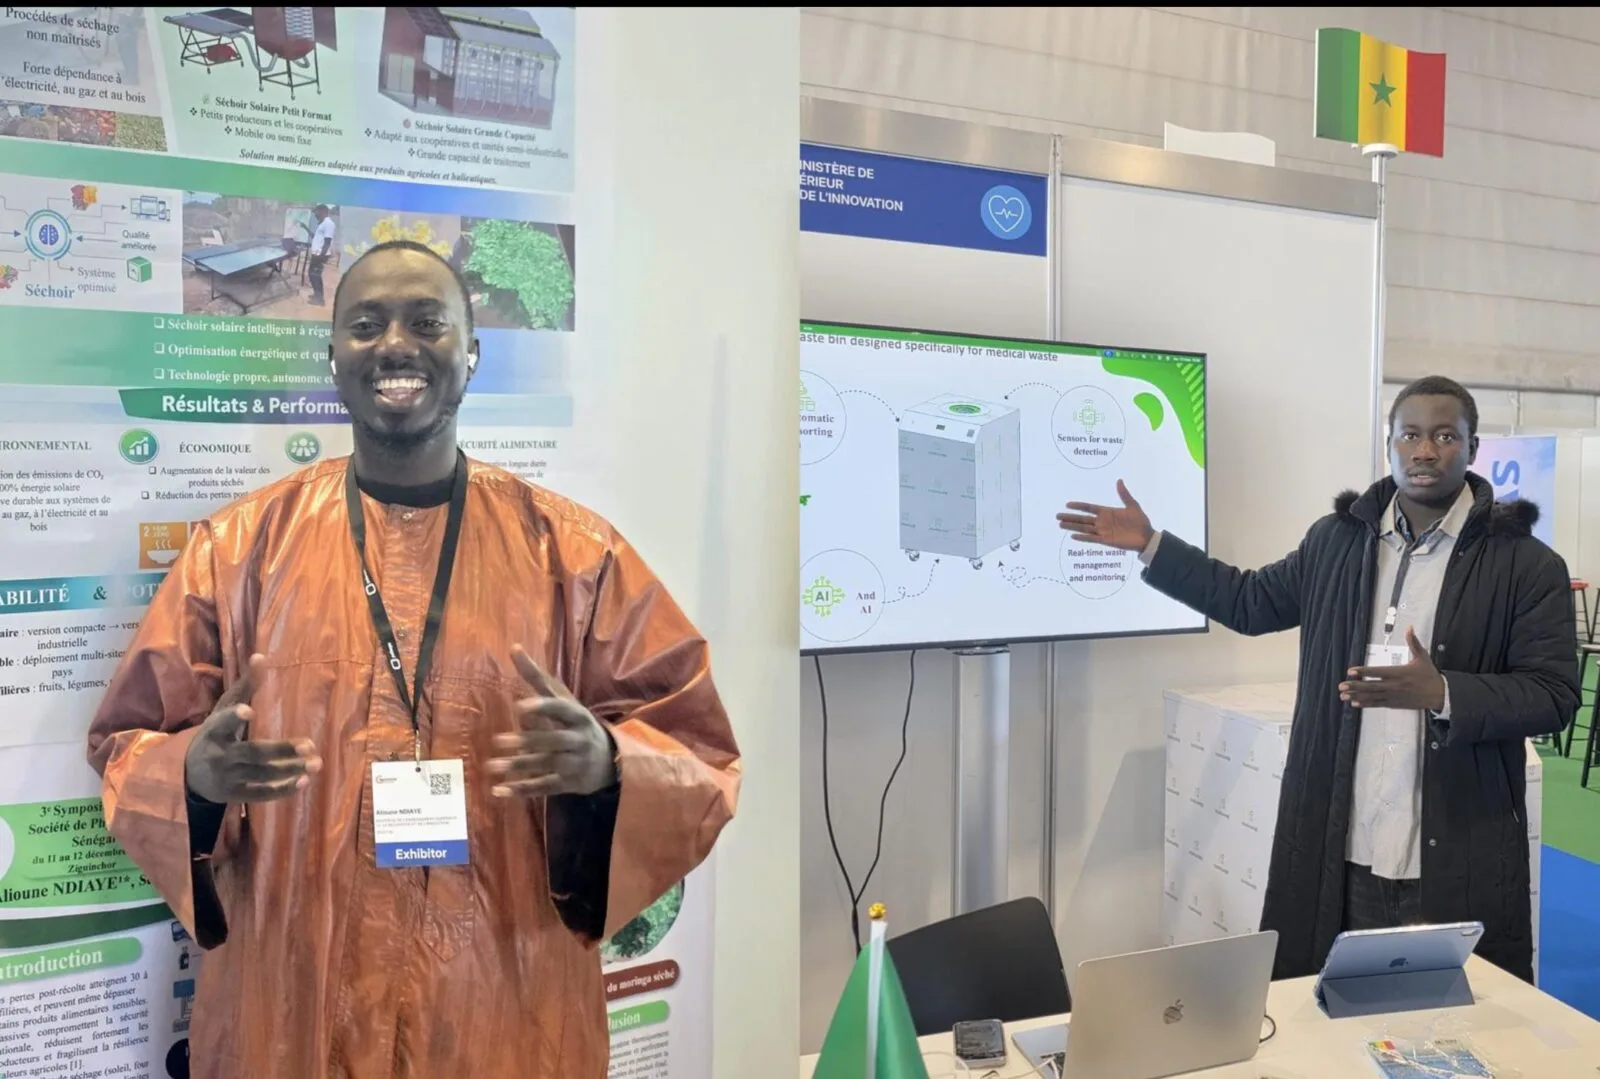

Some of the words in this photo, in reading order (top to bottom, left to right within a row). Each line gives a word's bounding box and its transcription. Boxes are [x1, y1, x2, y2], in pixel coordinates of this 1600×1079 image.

[6, 7, 58, 24] Procédés
[60, 14, 74, 26] de
[76, 18, 120, 35] séchage
[26, 30, 48, 41] non
[23, 61, 51, 75] Forte
[54, 65, 114, 84] dépendance
[116, 73, 122, 84] à
[63, 86, 76, 94] au
[78, 88, 96, 98] gaz
[99, 90, 108, 98] et
[111, 92, 122, 100] au
[125, 92, 146, 103] bois
[216, 97, 248, 110] Séchoir
[250, 101, 279, 114] Solaire
[282, 106, 300, 116] Petit
[302, 109, 332, 121] Format
[201, 109, 223, 120] Petits
[225, 113, 272, 126] producteurs
[284, 120, 294, 129] les
[296, 122, 343, 136] coopératives
[235, 127, 264, 139] Mobile
[266, 133, 276, 141] ou
[278, 134, 295, 143] semi
[297, 135, 311, 145] fixe
[415, 120, 443, 132] Séchoir
[446, 124, 472, 135] Solaire
[474, 127, 503, 139] Grande
[240, 149, 274, 161] Solution
[417, 150, 447, 161] Grande
[800, 160, 855, 177] INISTÈRE
[858, 167, 874, 179] DE
[800, 172, 844, 189] ÉRIEUR
[800, 189, 816, 201] DE
[819, 191, 903, 211] L’INNOVATION
[122, 230, 150, 240] Qualité
[121, 241, 157, 252] améliorée
[77, 267, 116, 279] Système
[25, 284, 75, 299] Séchoir
[77, 282, 116, 294] optimisé
[168, 318, 207, 331] Séchoir
[211, 321, 245, 333] solaire
[247, 323, 296, 337] intelligent
[300, 325, 305, 336] à
[168, 343, 236, 357] Optimisation
[240, 347, 297, 362] énergétique
[300, 351, 310, 360] et
[800, 334, 824, 343] aste
[828, 334, 846, 345] bin
[850, 336, 901, 350] designed
[905, 340, 964, 357] specifically
[968, 345, 982, 356] for
[986, 346, 1026, 359] medical
[1029, 351, 1058, 362] waste
[168, 369, 230, 383] Technologie
[233, 373, 270, 385] propre,
[273, 374, 322, 384] autonome
[162, 394, 247, 413] Résultats
[252, 400, 264, 413] &
[800, 414, 834, 423] omatic
[500, 440, 557, 448] ALIMENTAIRE
[1057, 434, 1087, 443] Sensors
[179, 441, 251, 454] ÉCONOMIQUE
[1074, 447, 1108, 456] detection
[16, 471, 29, 479] des
[32, 471, 72, 479] émissions
[75, 470, 84, 478] de
[160, 467, 213, 476] Augmentation
[21, 483, 51, 493] énergie
[53, 483, 80, 492] solaire
[189, 479, 218, 488] produits
[12, 497, 44, 505] durable
[63, 496, 99, 506] systèmes
[101, 495, 111, 503] de
[210, 492, 231, 502] pertes
[15, 512, 31, 520] gaz,
[30, 522, 48, 531] bois
[1073, 562, 1121, 570] management
[1086, 573, 1125, 582] monitoring
[92, 586, 107, 600] &
[816, 591, 829, 601] AI
[856, 592, 876, 600] And
[861, 605, 871, 614] AI
[27, 626, 61, 636] version
[63, 623, 106, 637] compacte
[37, 638, 88, 650] industrielle
[22, 653, 84, 667] déploiement
[51, 668, 73, 679] pays
[39, 680, 65, 693] fruits,
[67, 678, 108, 691] légumes,
[28, 821, 71, 835] Société
[74, 819, 87, 831] de
[33, 855, 44, 864] du
[47, 855, 56, 864] 11
[59, 854, 71, 862] au
[73, 851, 83, 861] 12
[396, 848, 447, 860] Exhibitor
[68, 861, 117, 874] Ziguinchor
[9, 993, 35, 1005] pertes
[39, 984, 86, 1000] post-récolte
[89, 976, 127, 988] atteignent
[131, 972, 140, 982] 30
[607, 983, 618, 992] du
[620, 976, 652, 989] moringa
[34, 1004, 41, 1012] et
[44, 998, 76, 1012] peuvent
[78, 994, 101, 1005] même
[103, 987, 136, 999] dépasser
[23, 1015, 58, 1028] produits
[61, 1003, 108, 1020] alimentaires
[37, 1019, 98, 1037] compromettent
[106, 1016, 113, 1025] la
[119, 1010, 148, 1022] sécurité
[44, 1036, 82, 1049] réduisent
[92, 1026, 129, 1040] fortement
[138, 1022, 148, 1031] les
[56, 1046, 98, 1060] fragilisent
[102, 1043, 110, 1052] la
[113, 1035, 148, 1050] résilience
[29, 1063, 68, 1076] agricoles
[134, 1060, 149, 1070] four
